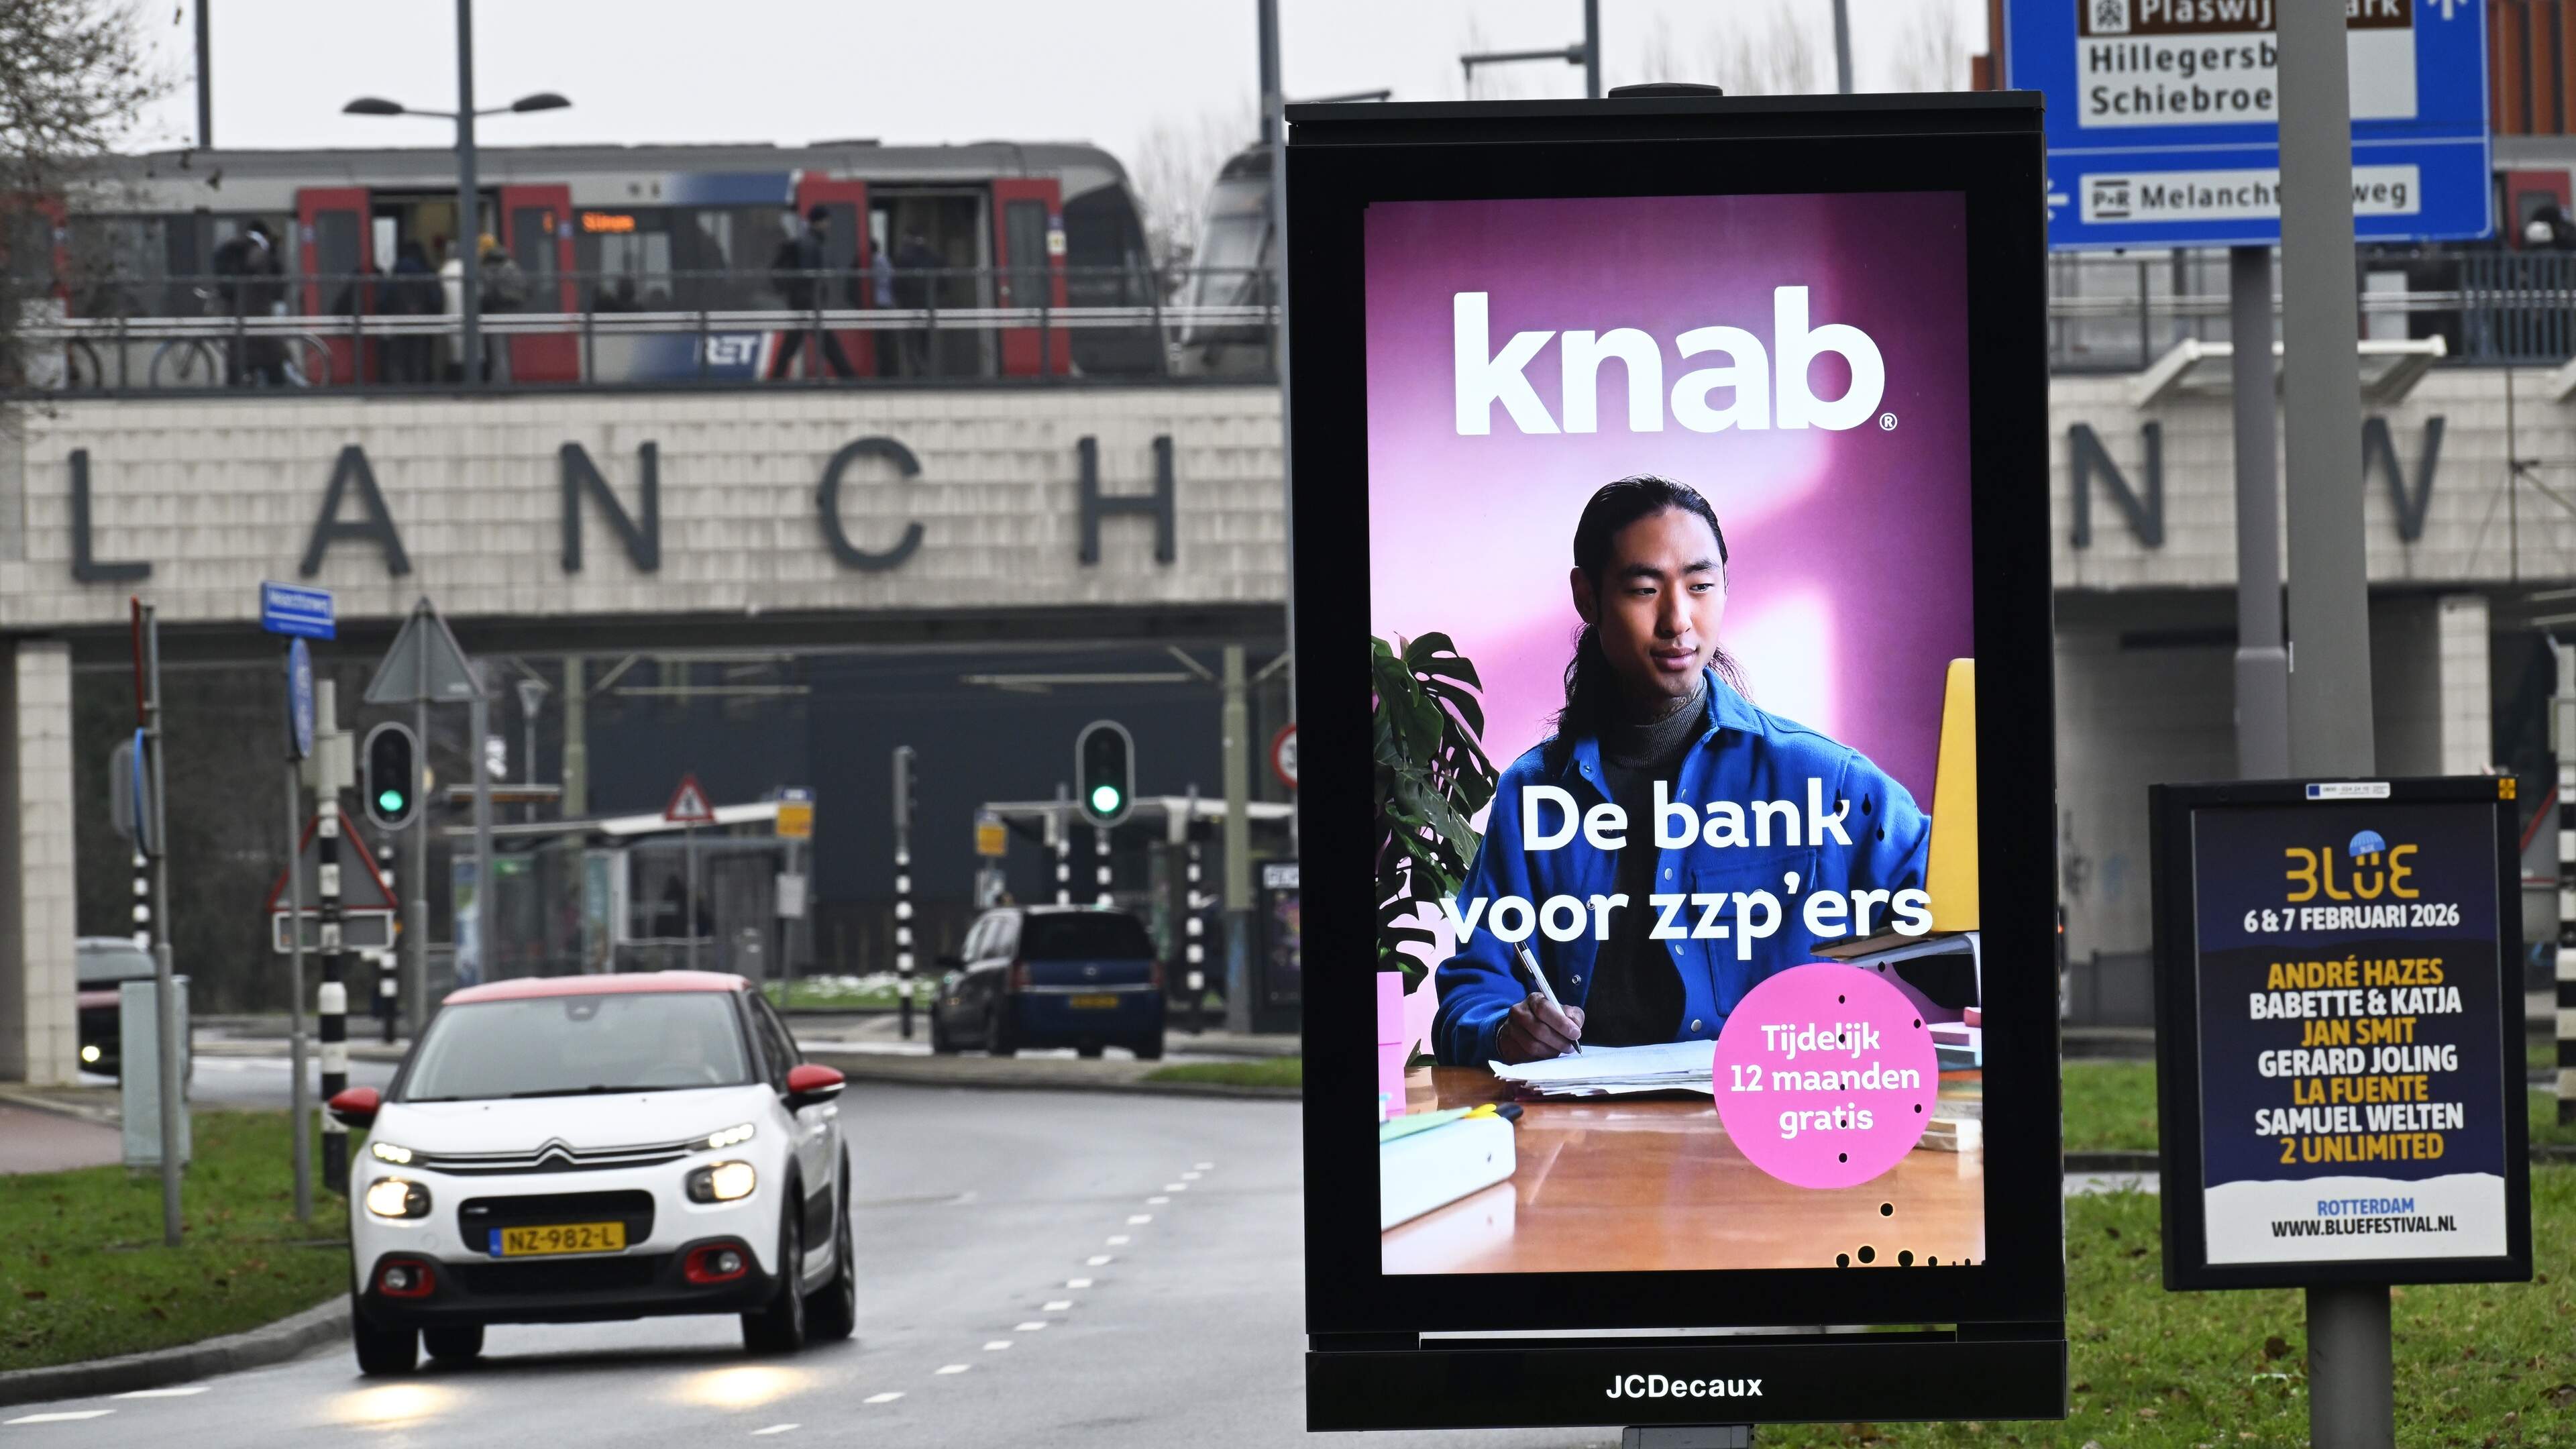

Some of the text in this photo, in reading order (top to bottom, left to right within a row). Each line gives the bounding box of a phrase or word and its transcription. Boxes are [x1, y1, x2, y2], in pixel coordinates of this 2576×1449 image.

[2140, 0, 2401, 29] Plaswijark
[2090, 42, 2277, 78] Hillegersb
[2090, 84, 2273, 115] Schiebroe
[2140, 180, 2406, 209] Melanchtweg
[1522, 777, 1853, 851] De bank
[1439, 871, 1934, 961] voor zzp'ers
[2244, 903, 2460, 932] 6 & 7 FEBRUARI 2026
[2267, 954, 2444, 989] ANDRÉ HAZES
[2250, 986, 2463, 1020] BABETTE & KATJA
[1761, 1022, 1880, 1060] Tijdelijk
[2302, 1017, 2416, 1046] JAN SMIT
[1731, 1061, 1921, 1091] 12 maanden
[2258, 1044, 2458, 1077] GERARD JOLING
[2294, 1075, 2428, 1105] LA FUENTE
[1779, 1102, 1874, 1140] gratis
[2255, 1102, 2464, 1136] SAMUEL WELTEN
[2280, 1132, 2444, 1164] 2 UNLIMITED
[2317, 1197, 2415, 1217] ROTTERDAM
[508, 1227, 616, 1251] NZ-982-L
[2271, 1215, 2457, 1238] WWW.BLUEFESTIVAL.NL
[1606, 1375, 1764, 1399] JCDecaux
